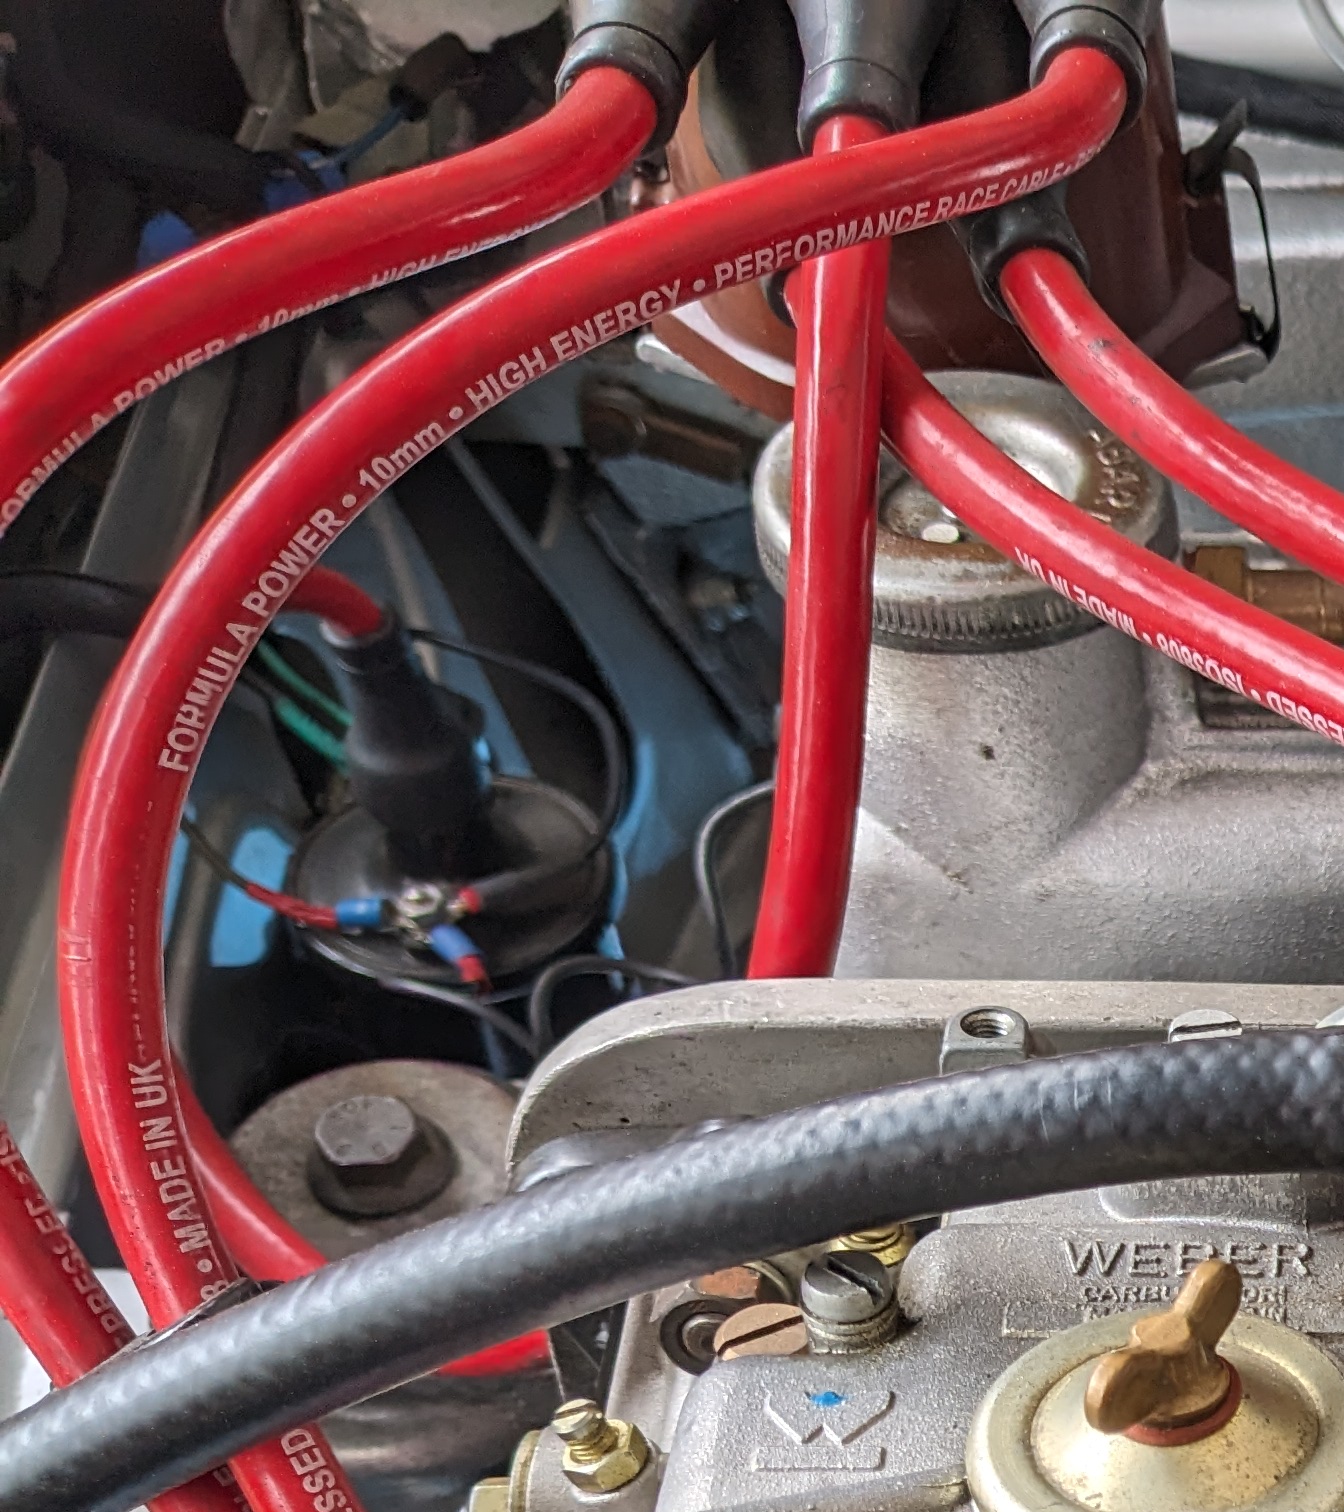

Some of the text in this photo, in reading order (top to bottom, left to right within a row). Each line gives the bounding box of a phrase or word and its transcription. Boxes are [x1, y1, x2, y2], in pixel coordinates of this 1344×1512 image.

[116, 337, 227, 409] POWER
[158, 620, 259, 773] FORMULA
[242, 507, 345, 617] POWER
[357, 420, 446, 492] 10mm
[467, 346, 550, 411] HIGH
[551, 279, 688, 361] ENERGY
[712, 198, 934, 288] PERFORMANCE
[931, 180, 1000, 224] RACE
[1047, 568, 1074, 600] IN
[1073, 586, 1140, 642] MADE
[127, 1057, 168, 1111] UK
[138, 1117, 179, 1152] IN
[151, 1153, 211, 1255] MADE
[1064, 1238, 1315, 1282] WEBER
